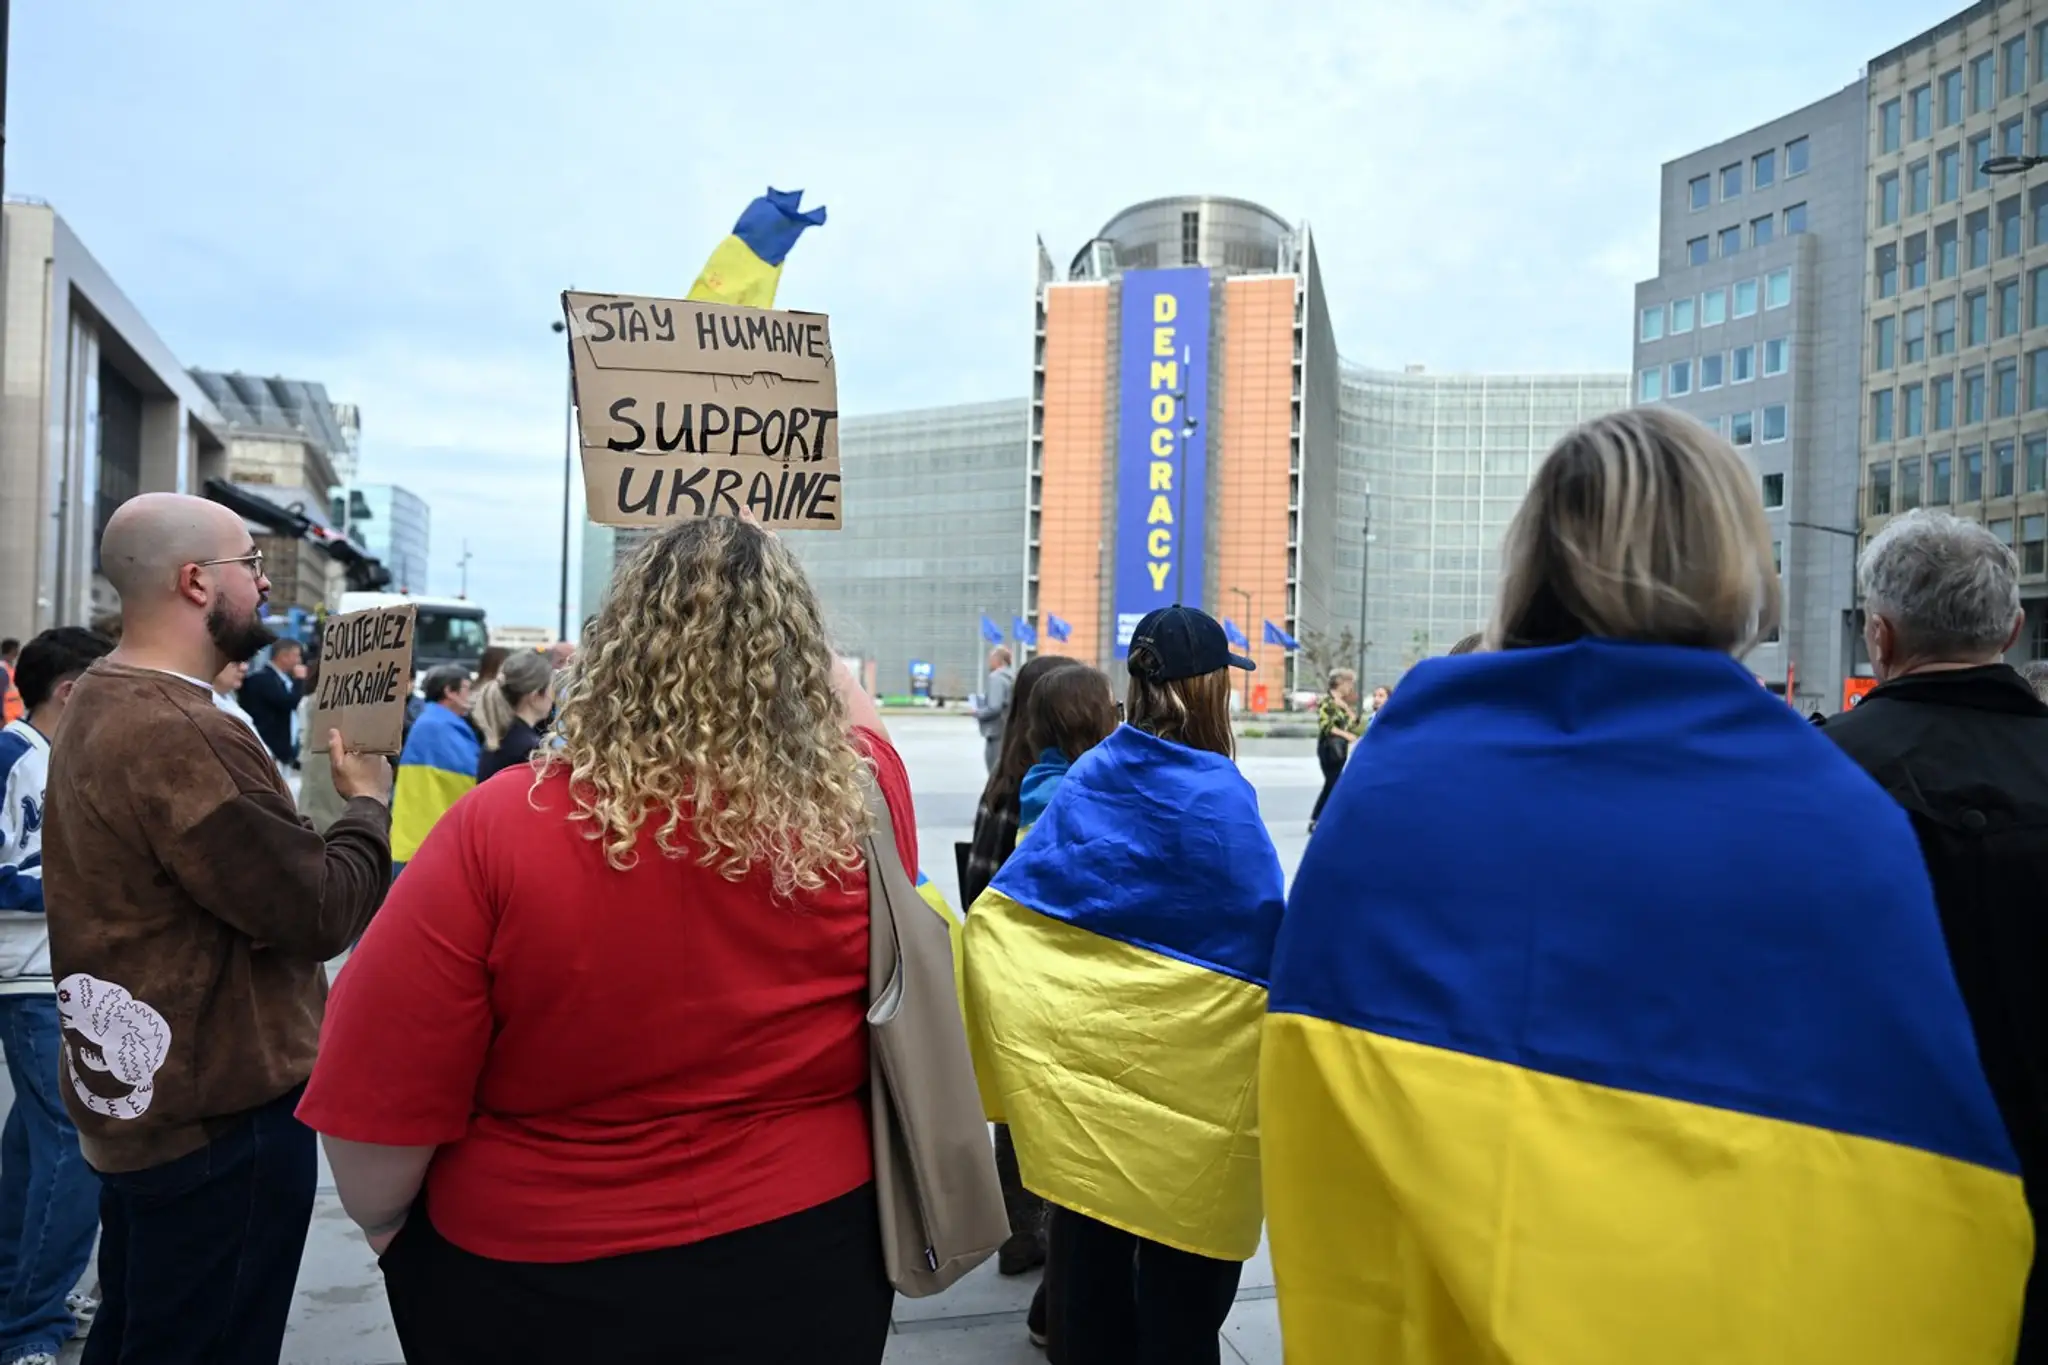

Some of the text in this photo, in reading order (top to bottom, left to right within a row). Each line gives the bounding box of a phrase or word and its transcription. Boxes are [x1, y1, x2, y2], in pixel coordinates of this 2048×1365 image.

[586, 302, 825, 358] STAY HUMANE
[607, 397, 838, 462] SUPPORT
[1147, 293, 1177, 591] DEMOCRACY
[324, 613, 407, 661] SOUTENEZ
